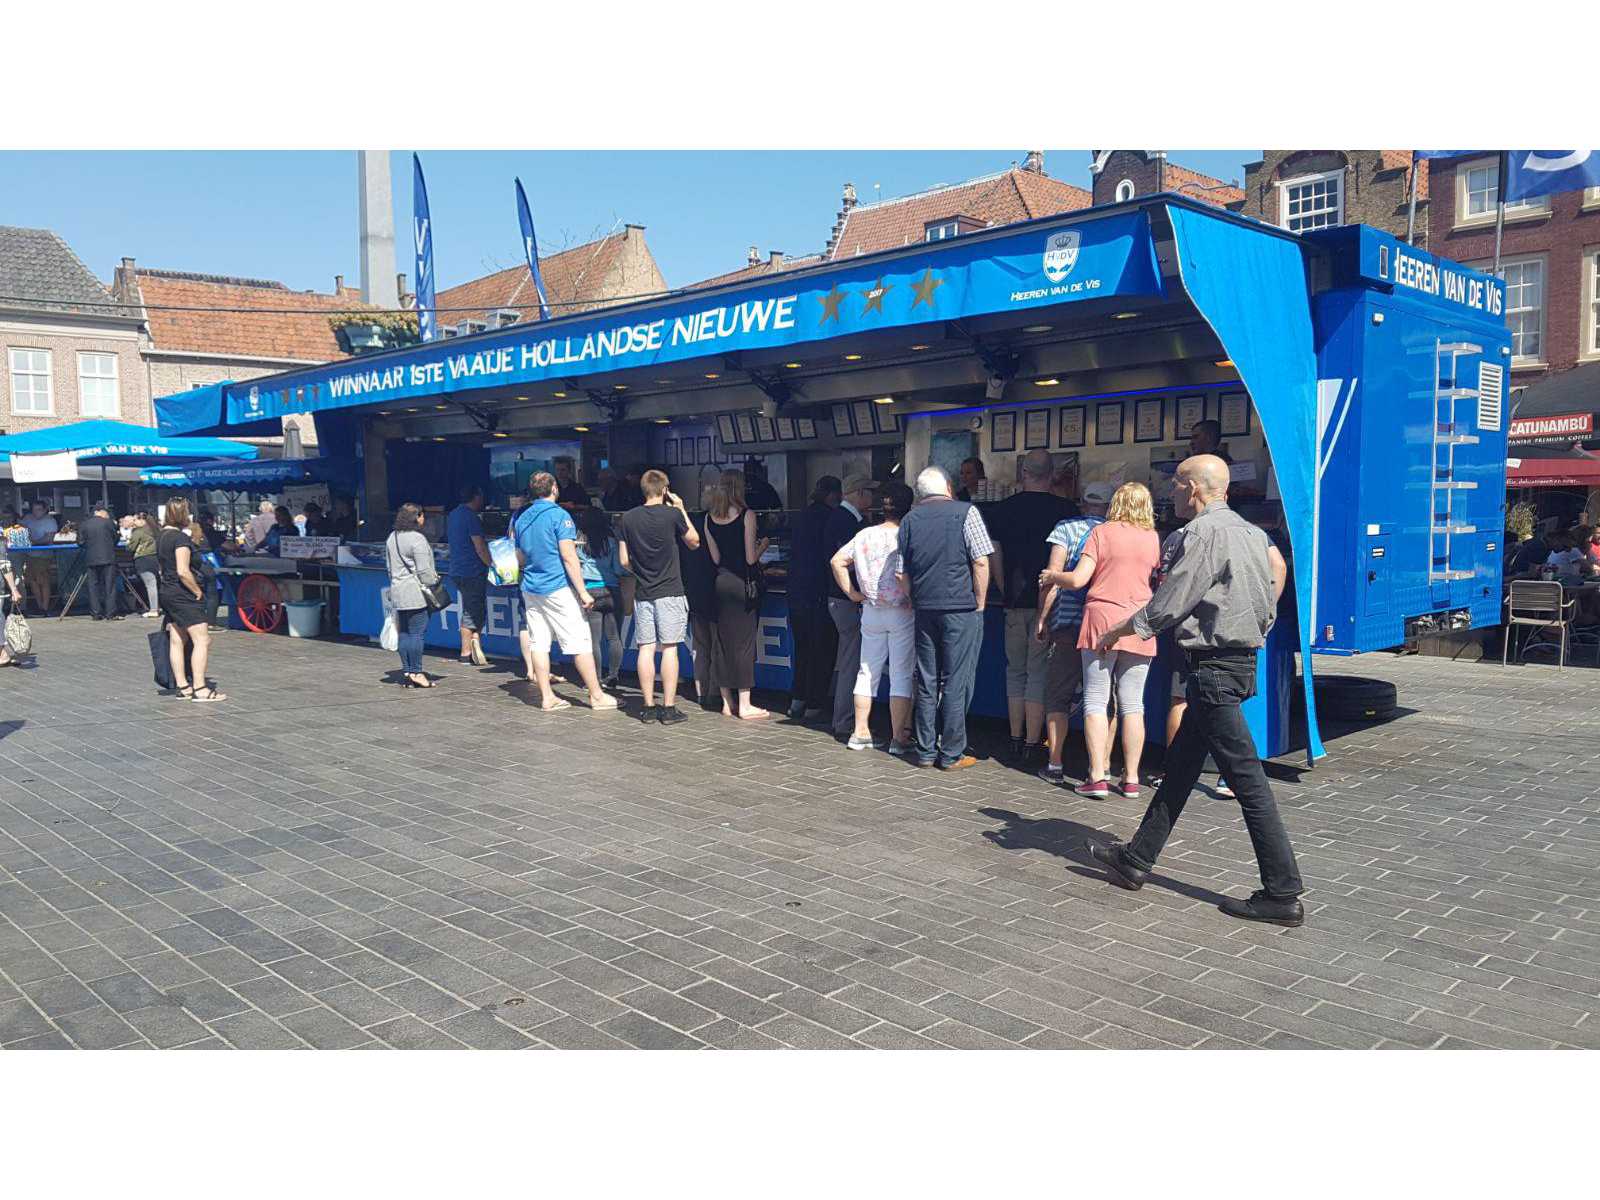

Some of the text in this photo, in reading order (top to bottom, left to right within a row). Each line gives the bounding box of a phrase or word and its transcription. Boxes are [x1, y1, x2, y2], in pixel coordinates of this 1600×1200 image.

[1010, 288, 1048, 302] HEEREN
[1050, 285, 1068, 296] VAN
[1070, 282, 1083, 292] DE
[1444, 270, 1465, 304] VAN
[1468, 279, 1482, 309] DE
[329, 294, 797, 398] WINNAAR 1STE VAATJE HOLLANDSE NIEUWE
[104, 444, 127, 454] VAN
[131, 445, 146, 454] DE
[1508, 439, 1531, 447] PANISH
[1534, 436, 1565, 444] PREMIUM
